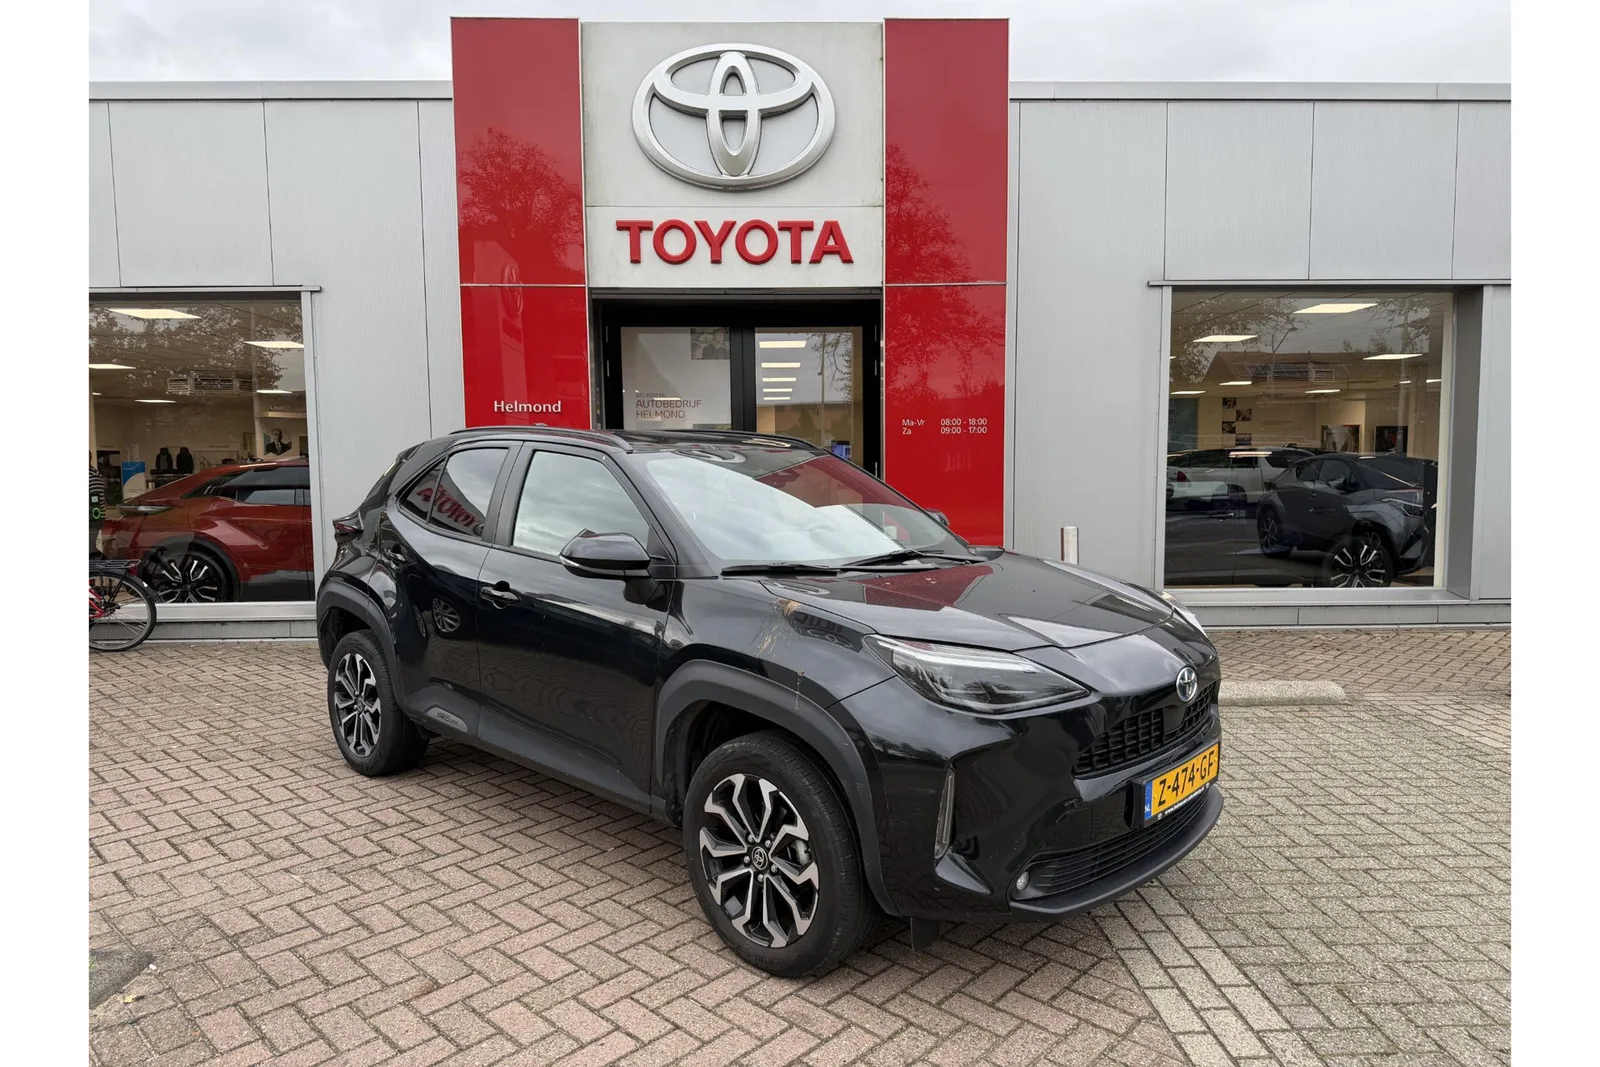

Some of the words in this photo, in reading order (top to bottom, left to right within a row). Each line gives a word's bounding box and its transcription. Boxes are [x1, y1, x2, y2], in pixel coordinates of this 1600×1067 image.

[616, 219, 854, 265] TOYOTA
[494, 400, 561, 413] Helmond
[636, 400, 702, 408] AUTOBEDRIJF
[636, 410, 686, 418] HELMOND
[940, 418, 962, 426] 08:00
[1158, 750, 1214, 807] Z-474-GF
